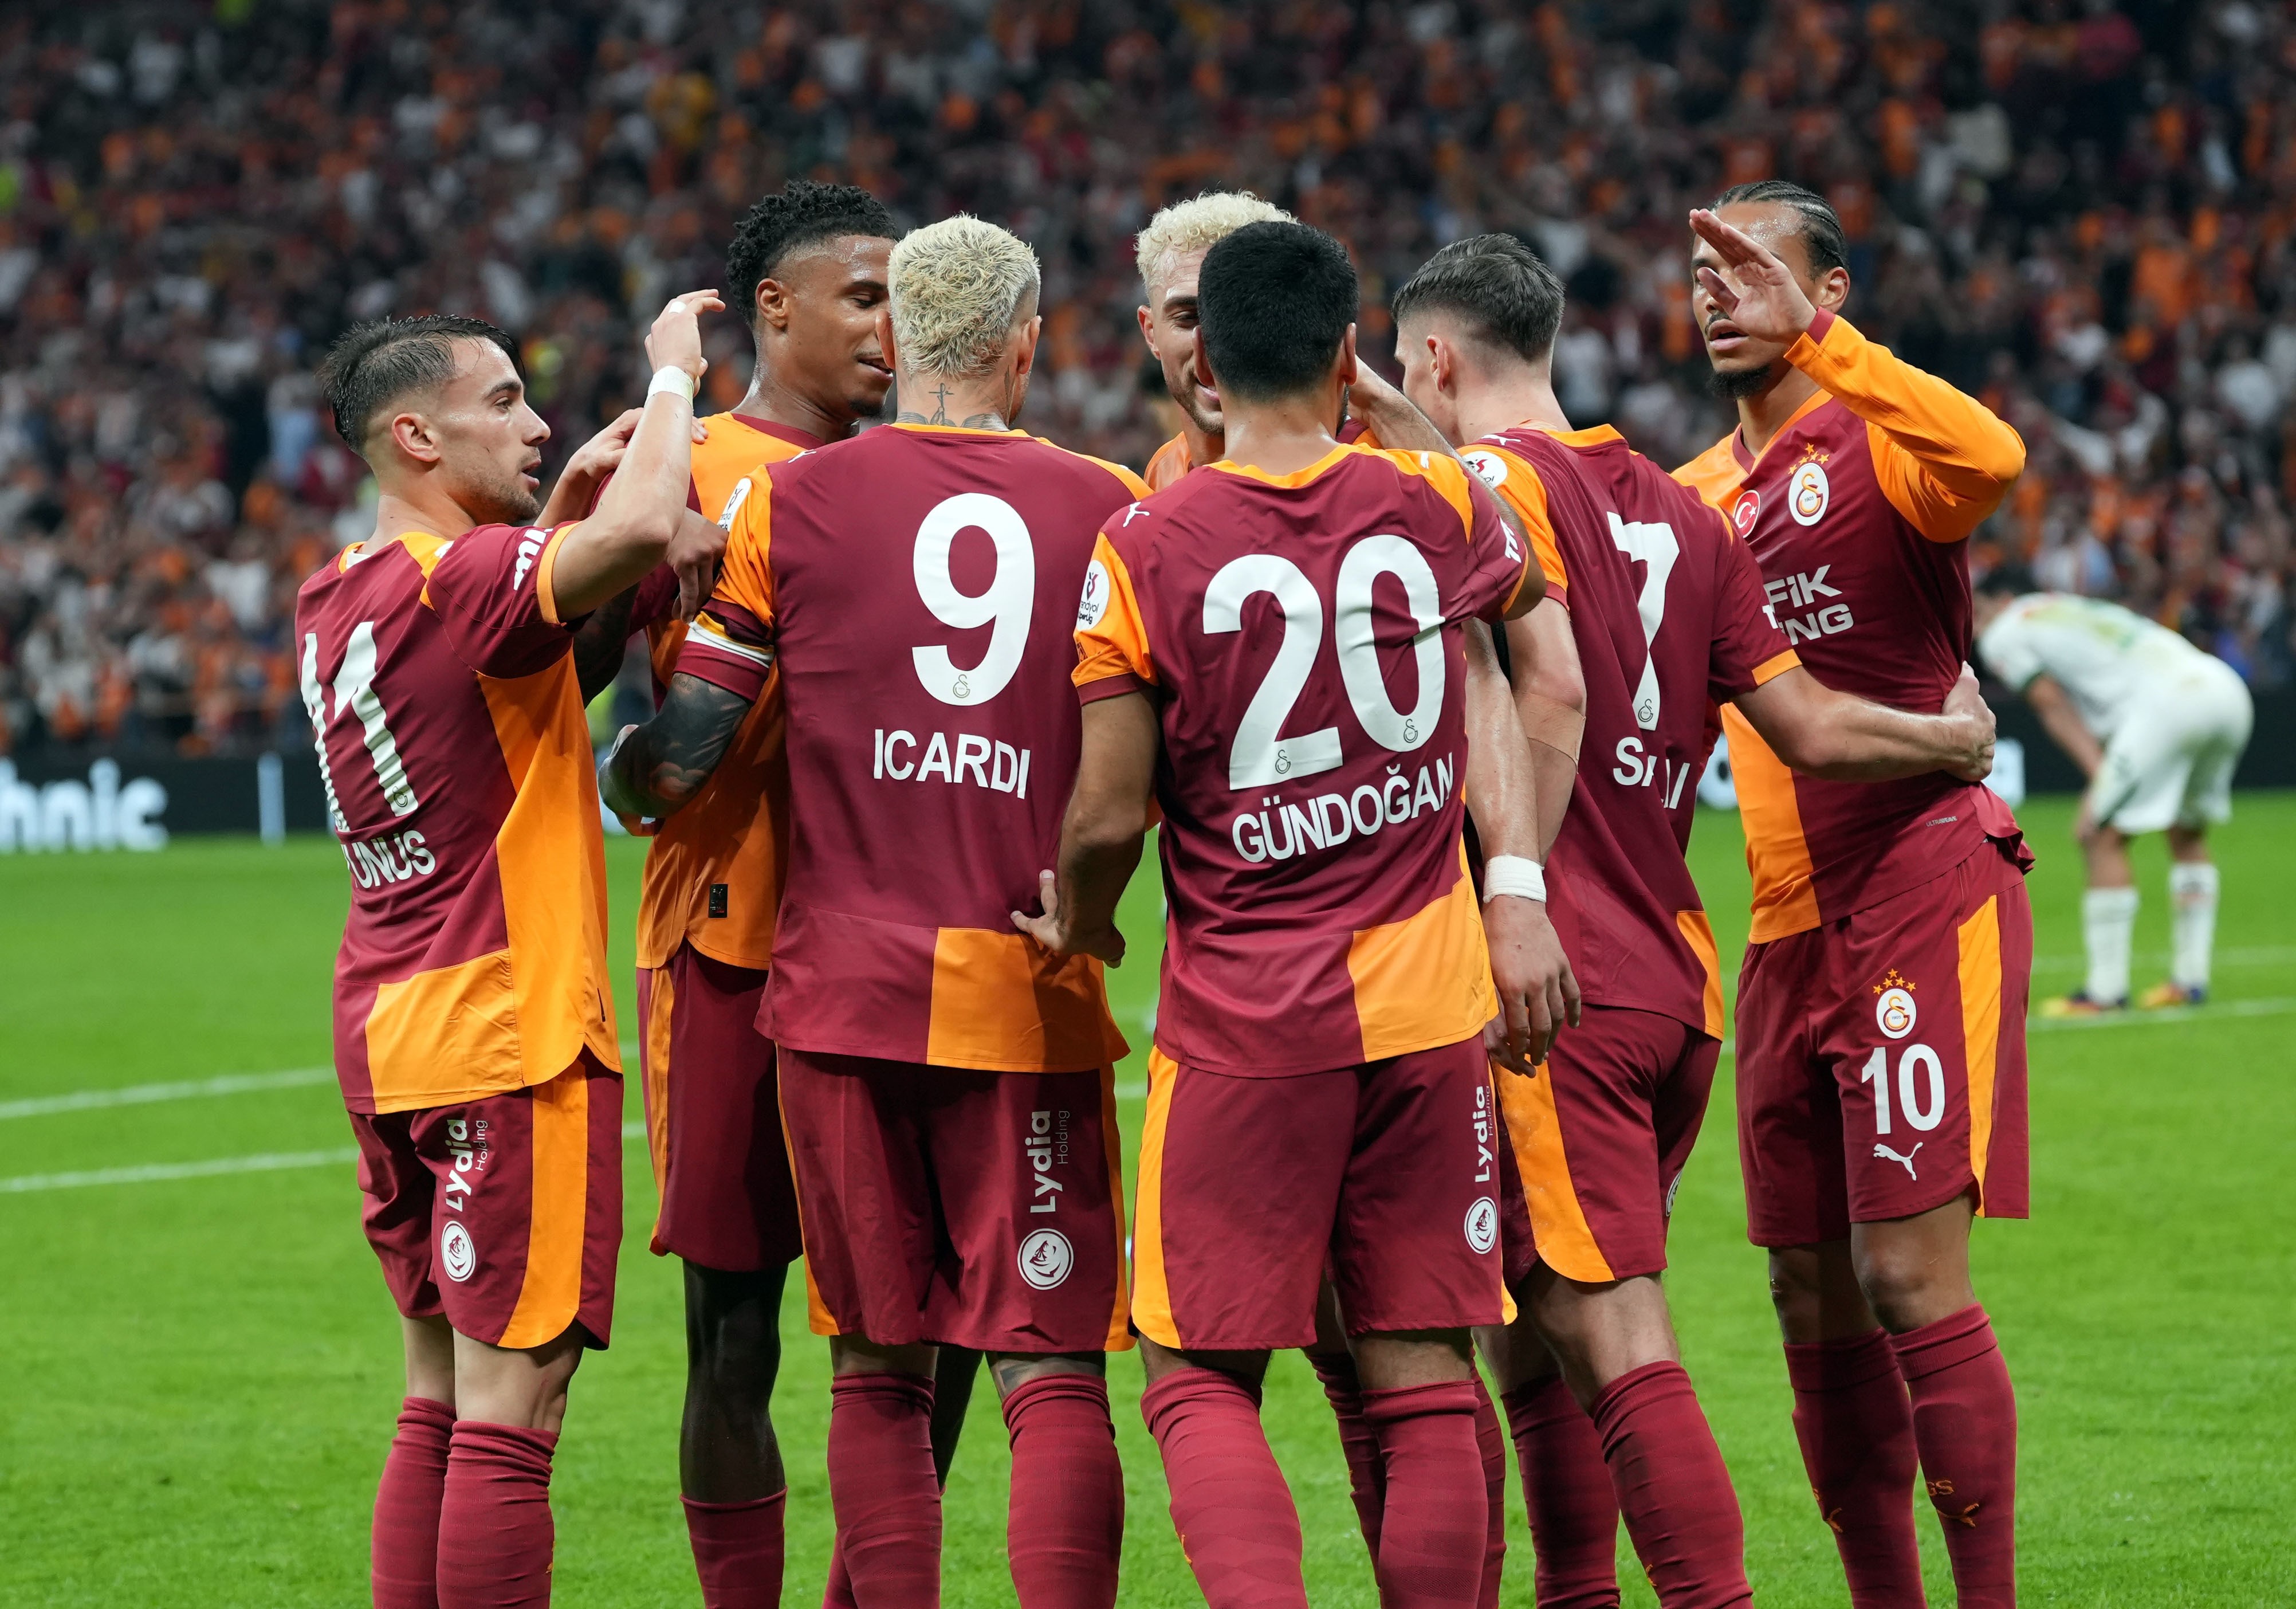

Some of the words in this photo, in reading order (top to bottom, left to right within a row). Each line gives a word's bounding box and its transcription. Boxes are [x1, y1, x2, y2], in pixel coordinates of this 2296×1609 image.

[911, 492, 1035, 706] 9
[1606, 511, 1680, 731] 7
[1203, 534, 1446, 791] 20
[300, 621, 419, 833] 11
[874, 729, 1031, 799] ICARDI
[1232, 752, 1454, 864] GÜNDOĞAN
[1055, 1110, 1070, 1164] Holding
[1472, 1086, 1493, 1183] Lydia
[1862, 1043, 1945, 1135] 10
[445, 1119, 474, 1212] Lydia
[474, 1120, 488, 1171] Holding
[1025, 1110, 1063, 1213] Lydia
